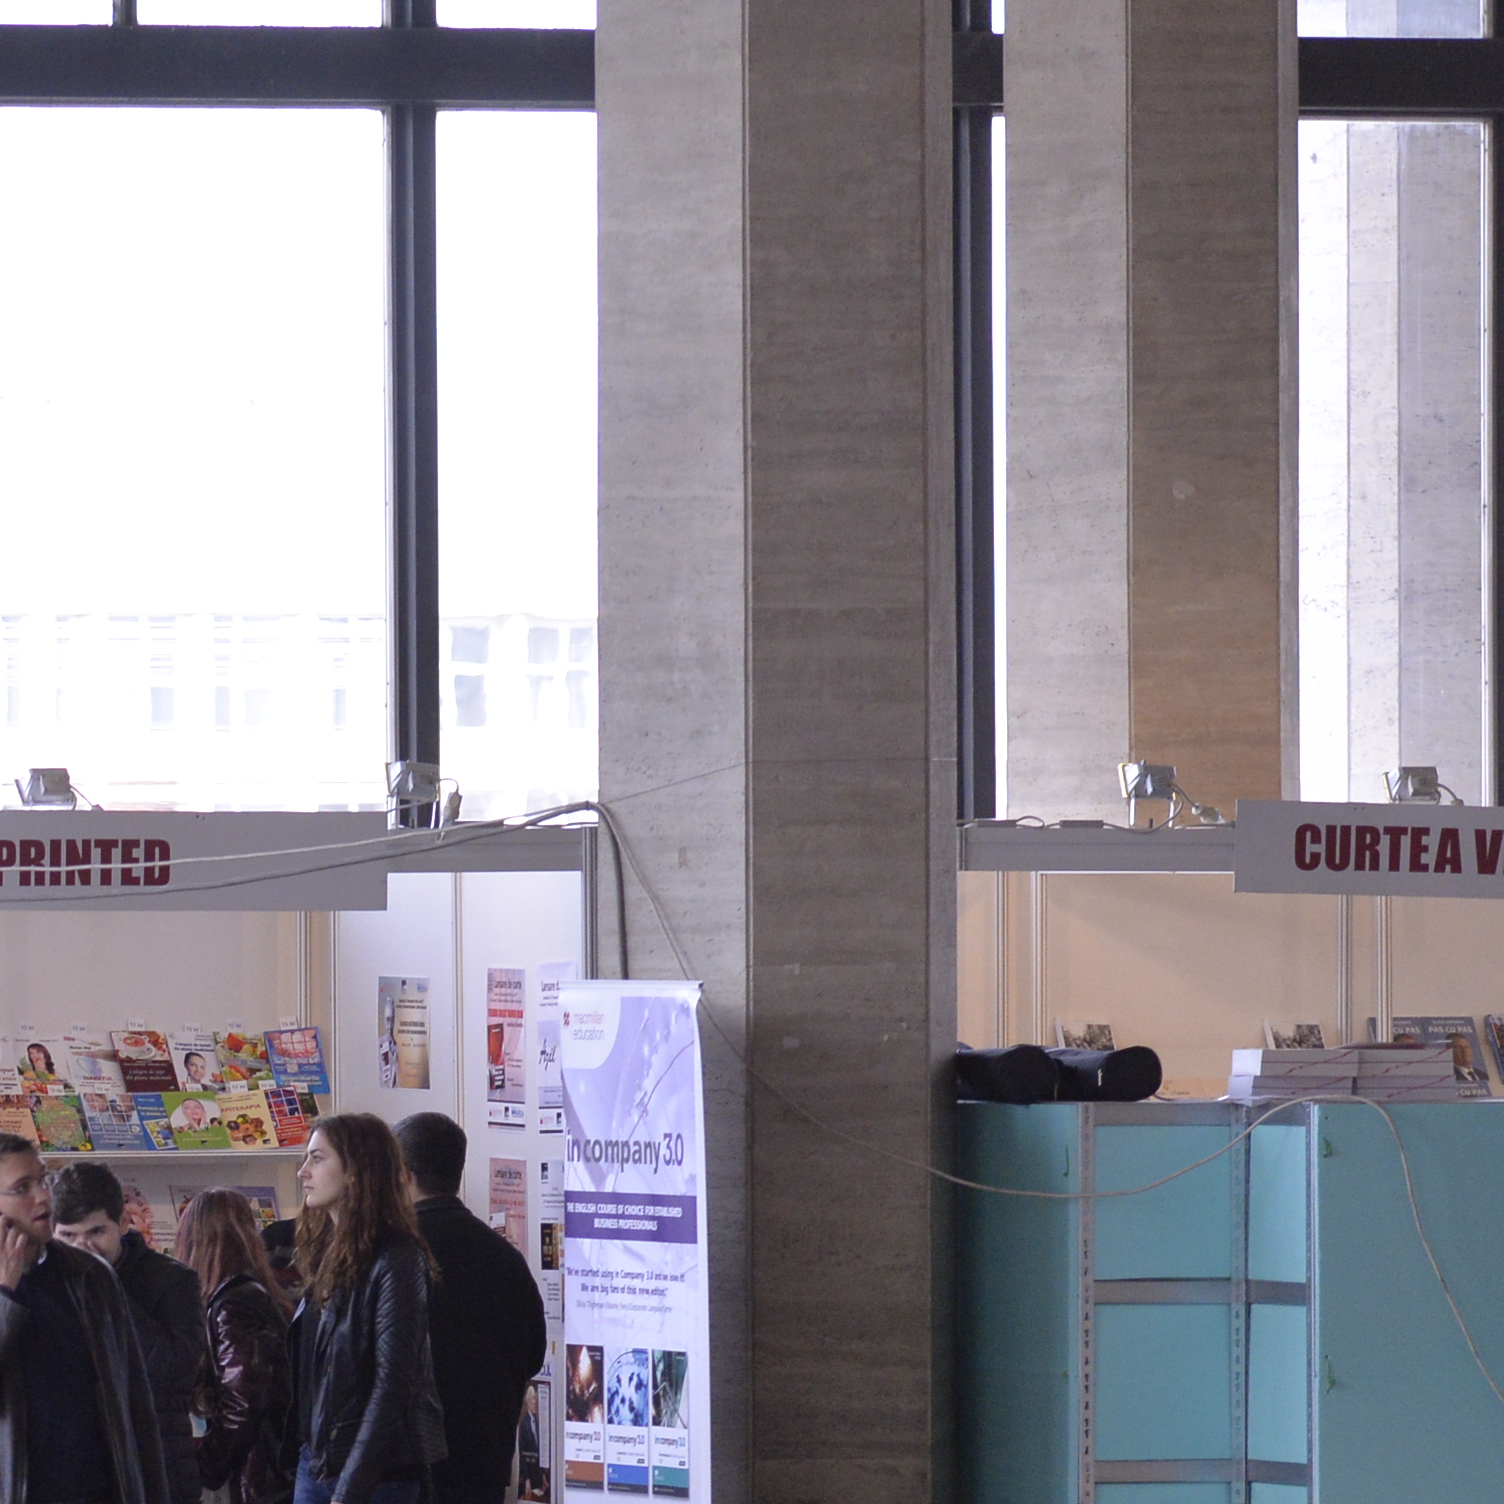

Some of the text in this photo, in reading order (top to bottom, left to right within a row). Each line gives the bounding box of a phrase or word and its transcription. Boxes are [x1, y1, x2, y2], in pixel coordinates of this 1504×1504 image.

[1294, 823, 1504, 876] CURTEA V
[567, 1130, 684, 1174] in company 3.0
